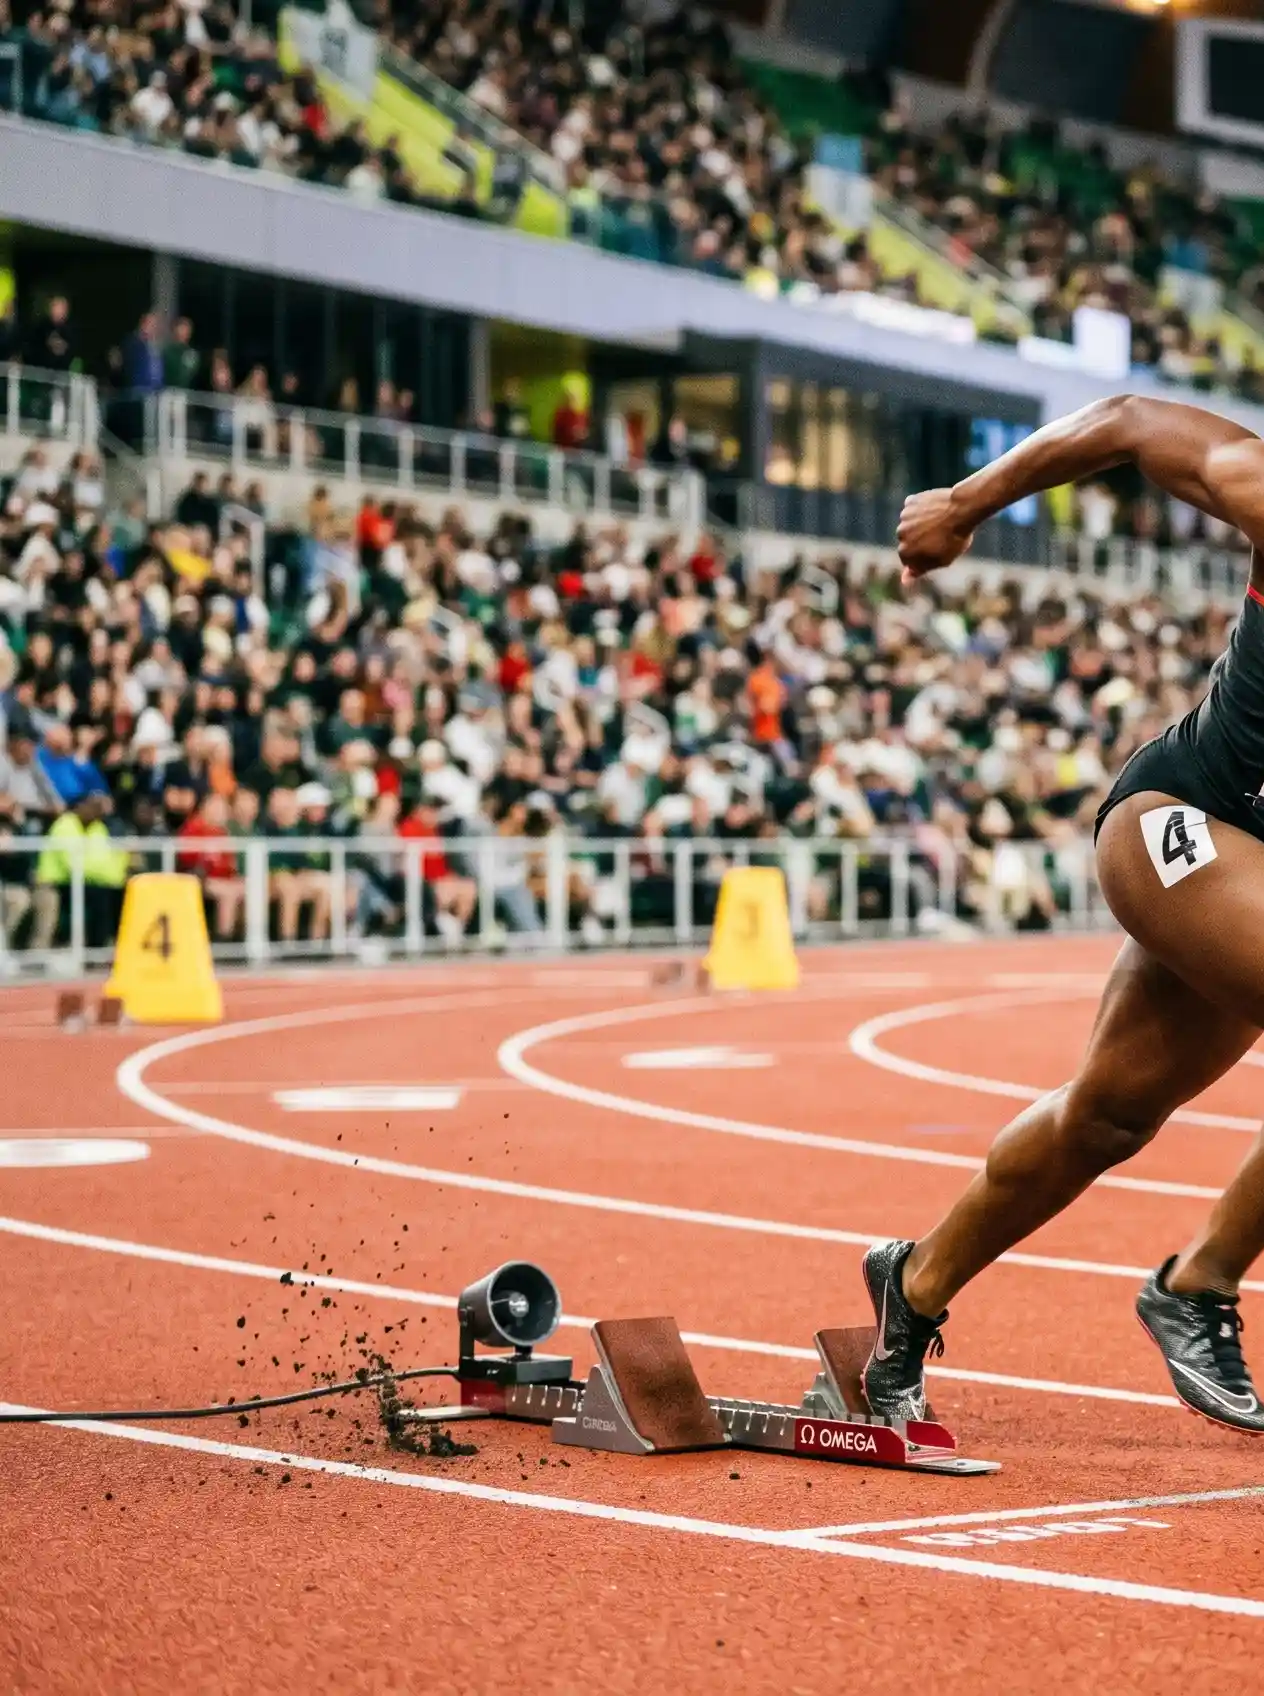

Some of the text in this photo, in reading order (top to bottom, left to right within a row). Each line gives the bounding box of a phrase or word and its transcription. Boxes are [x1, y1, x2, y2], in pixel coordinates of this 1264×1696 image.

[1161, 811, 1198, 867] 4
[140, 911, 174, 961] 4
[819, 1428, 878, 1454] OMEGA
